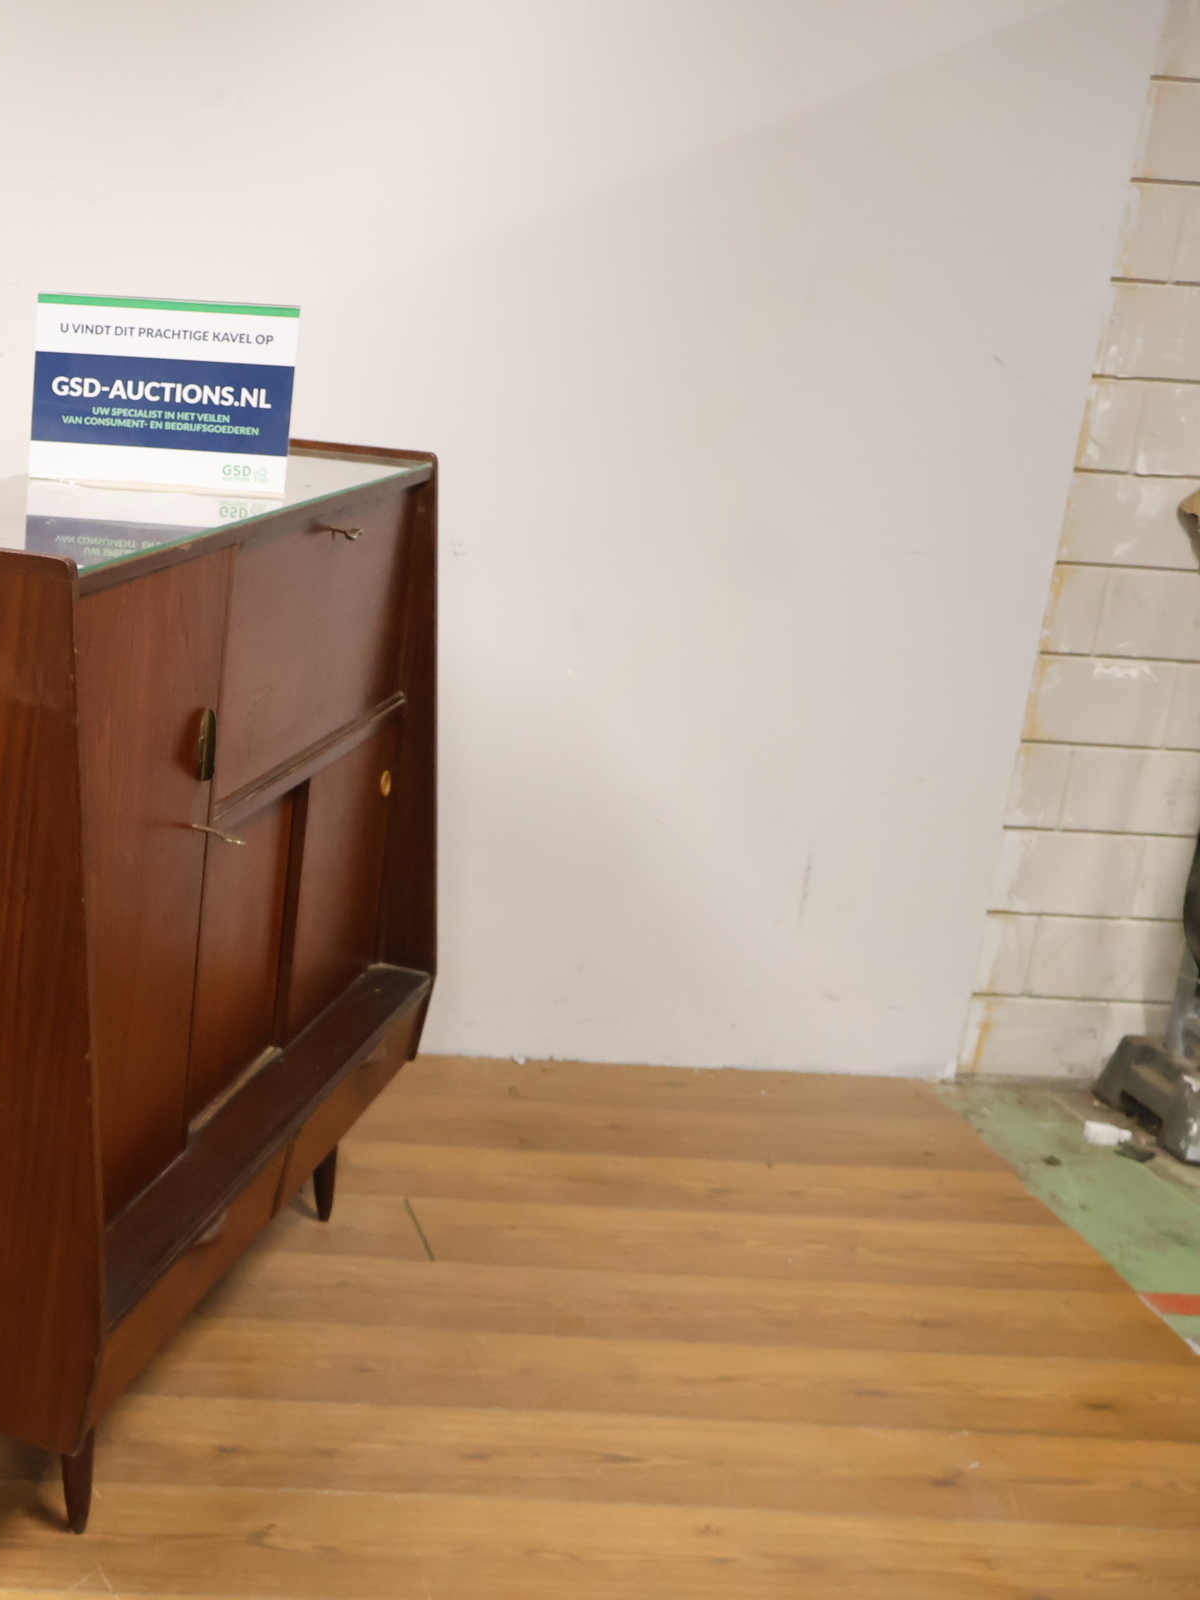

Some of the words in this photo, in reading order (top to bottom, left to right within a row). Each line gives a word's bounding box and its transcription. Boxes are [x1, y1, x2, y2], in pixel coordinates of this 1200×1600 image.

[59, 322, 69, 334] U
[72, 323, 112, 336] VINDT
[114, 325, 136, 337] DIT
[138, 327, 210, 342] PRACHTIGE
[212, 331, 253, 345] KAVEL
[255, 334, 275, 346] OP
[51, 375, 273, 410] GSD-AUCTIONS.NL
[61, 415, 83, 425] VAN
[84, 416, 148, 429] CONSUMENT-
[149, 420, 163, 430] EN
[164, 421, 260, 436] BEDRIJFSGOEDEREN
[91, 406, 111, 416] UW
[111, 407, 163, 420] SPECIALIST
[164, 411, 176, 420] IN
[176, 411, 196, 421] HET
[196, 413, 231, 424] VEILEN
[222, 464, 252, 477] GSD
